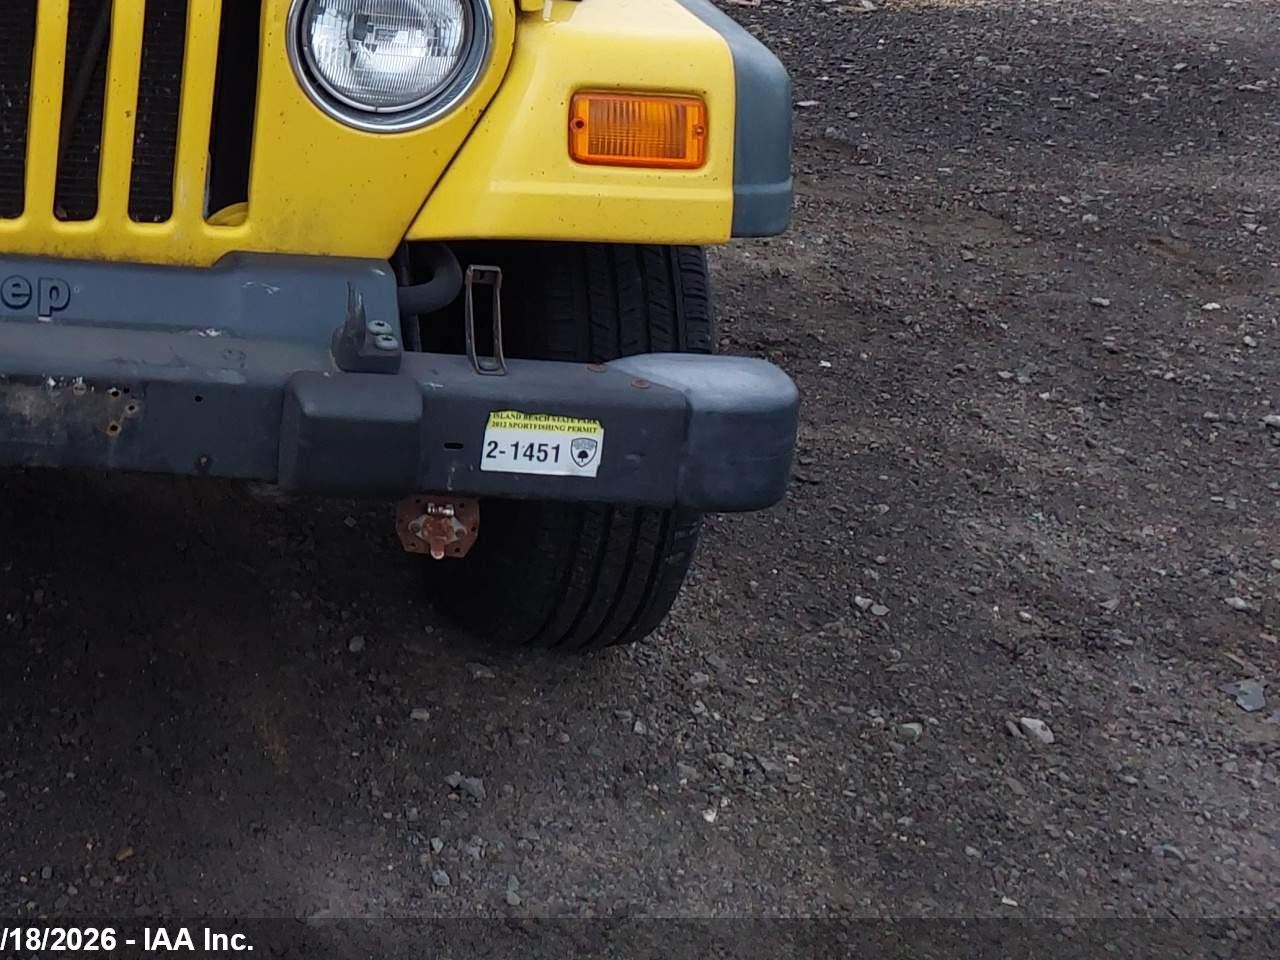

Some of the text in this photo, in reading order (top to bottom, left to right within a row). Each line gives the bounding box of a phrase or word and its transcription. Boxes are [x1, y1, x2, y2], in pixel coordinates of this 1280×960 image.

[492, 411, 522, 420] ISLAND
[567, 425, 598, 433] PERMIT
[486, 440, 560, 463] 2-1451
